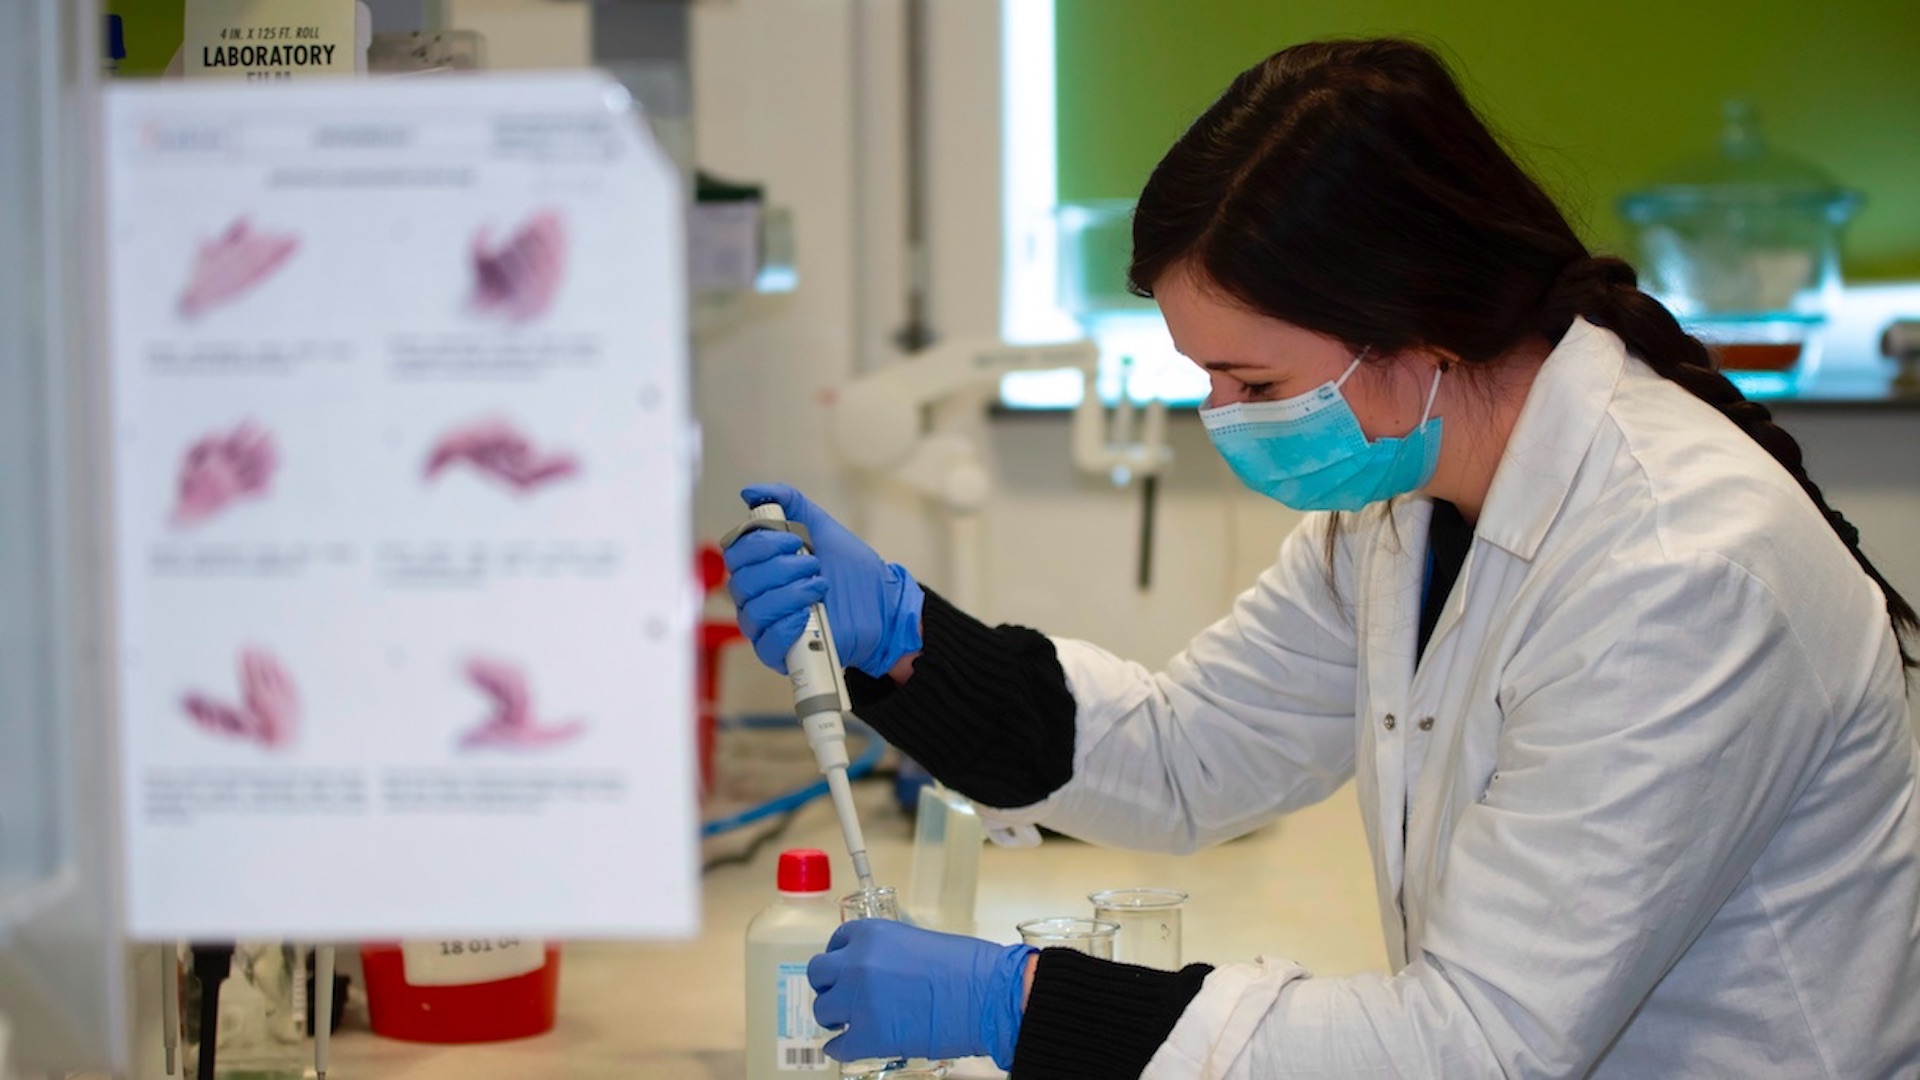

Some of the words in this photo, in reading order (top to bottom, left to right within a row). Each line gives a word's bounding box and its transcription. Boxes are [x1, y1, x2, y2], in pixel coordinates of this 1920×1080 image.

[220, 27, 227, 40] 4
[229, 27, 243, 40] IN.
[246, 27, 254, 40] X
[258, 26, 276, 40] 125
[279, 26, 292, 39] FT.
[296, 26, 319, 39] ROLL
[203, 44, 334, 67] LABORATORY
[441, 940, 464, 956] 18
